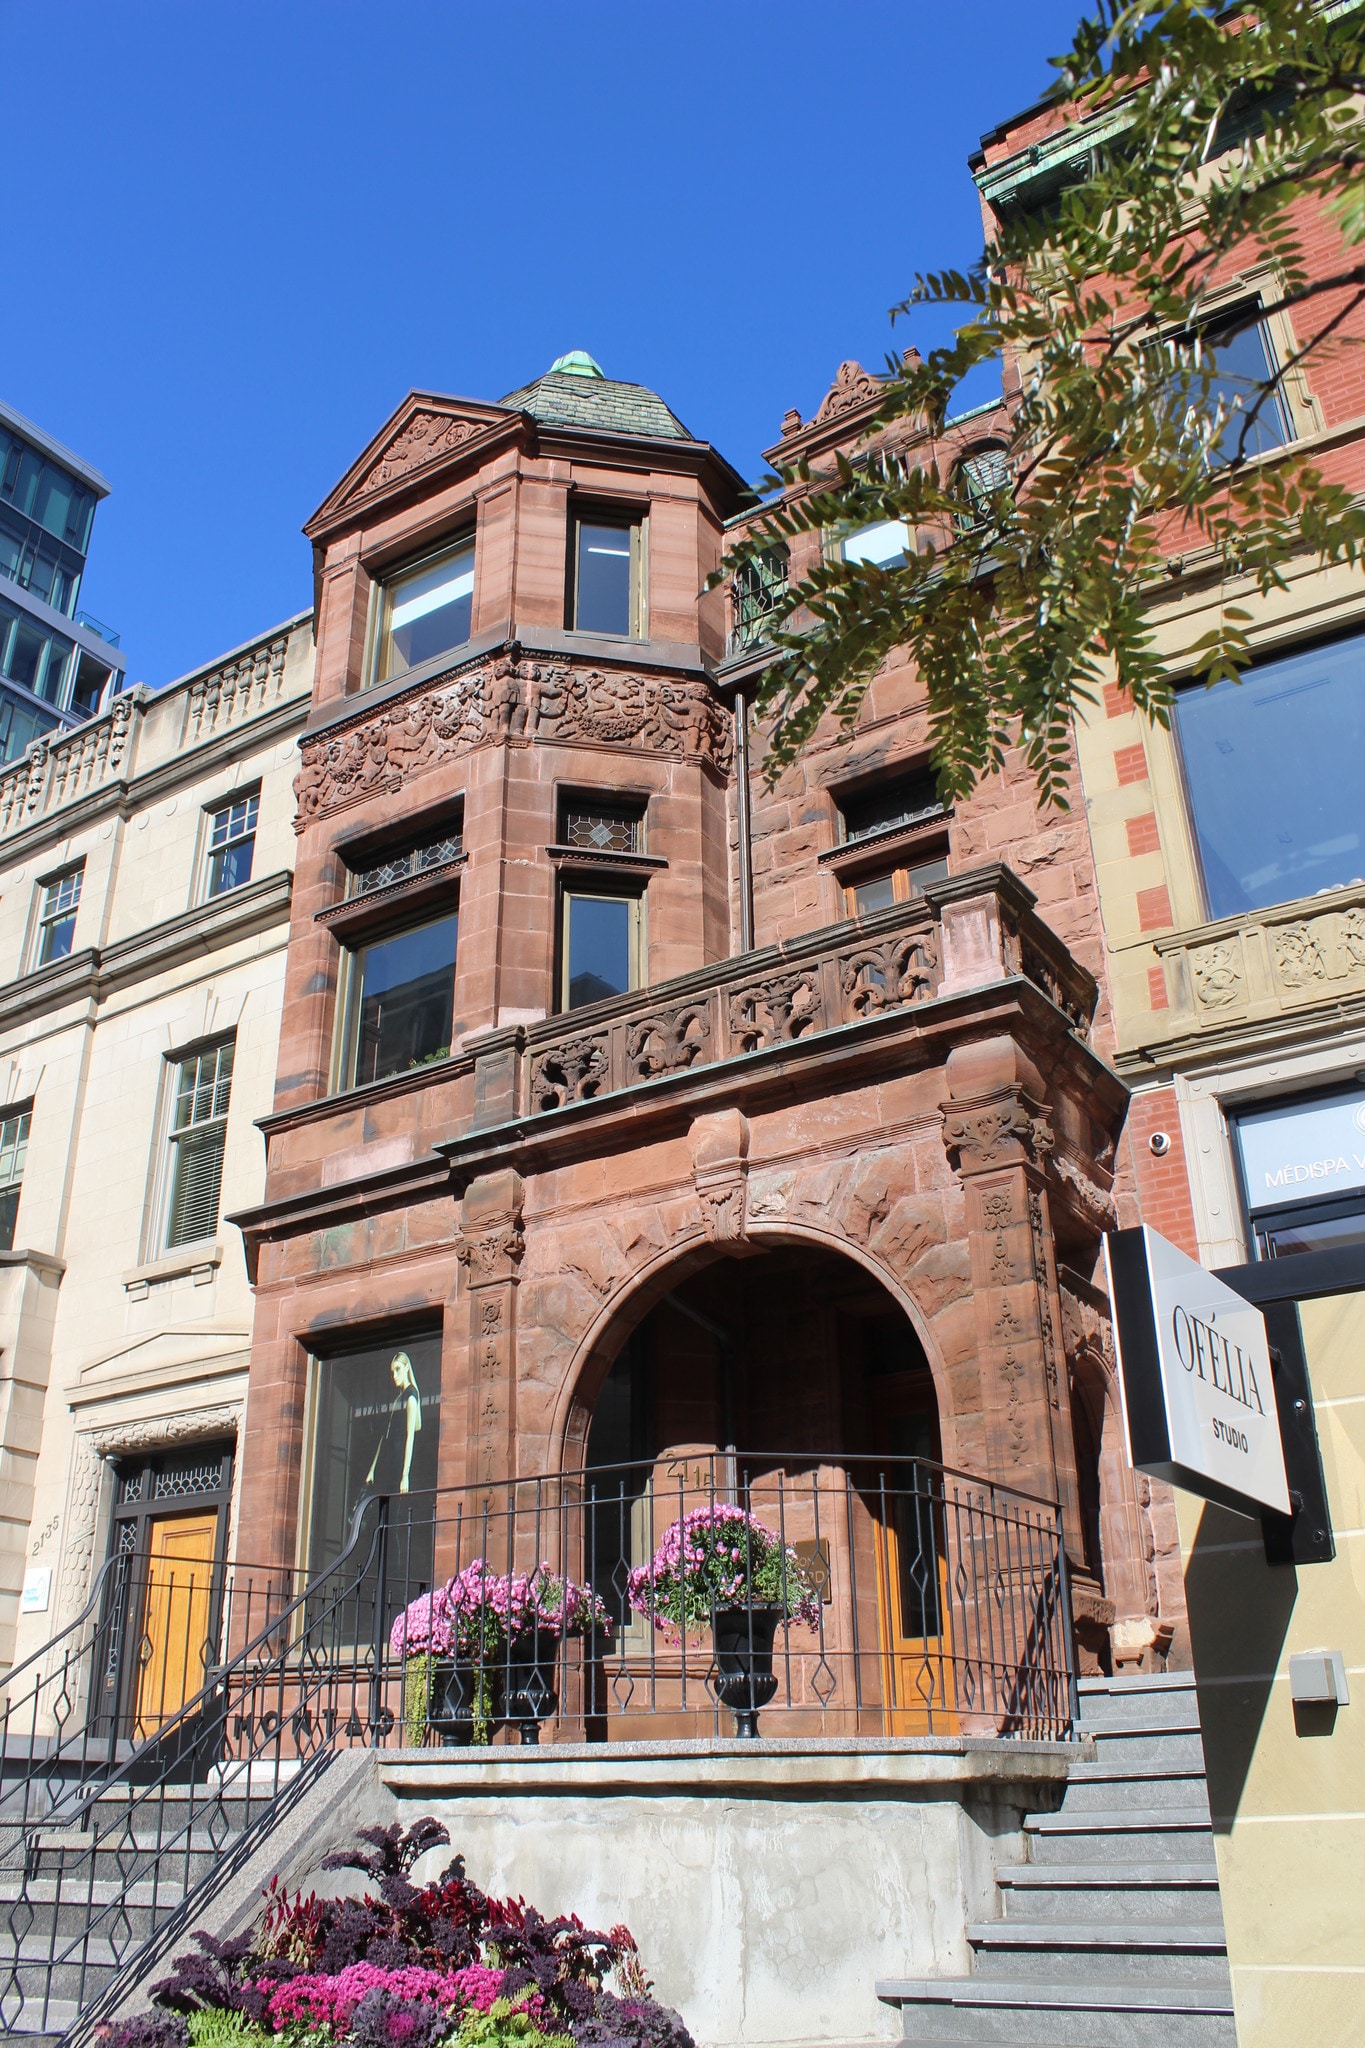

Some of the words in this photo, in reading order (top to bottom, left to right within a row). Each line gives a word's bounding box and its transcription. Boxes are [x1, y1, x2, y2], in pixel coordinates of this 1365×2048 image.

[1265, 1157, 1350, 1188] MÉDISPA
[1172, 1305, 1267, 1417] OFÉLIA
[1212, 1417, 1249, 1454] STUDIO
[666, 1453, 717, 1498] 2115
[32, 1515, 59, 1556] 2135
